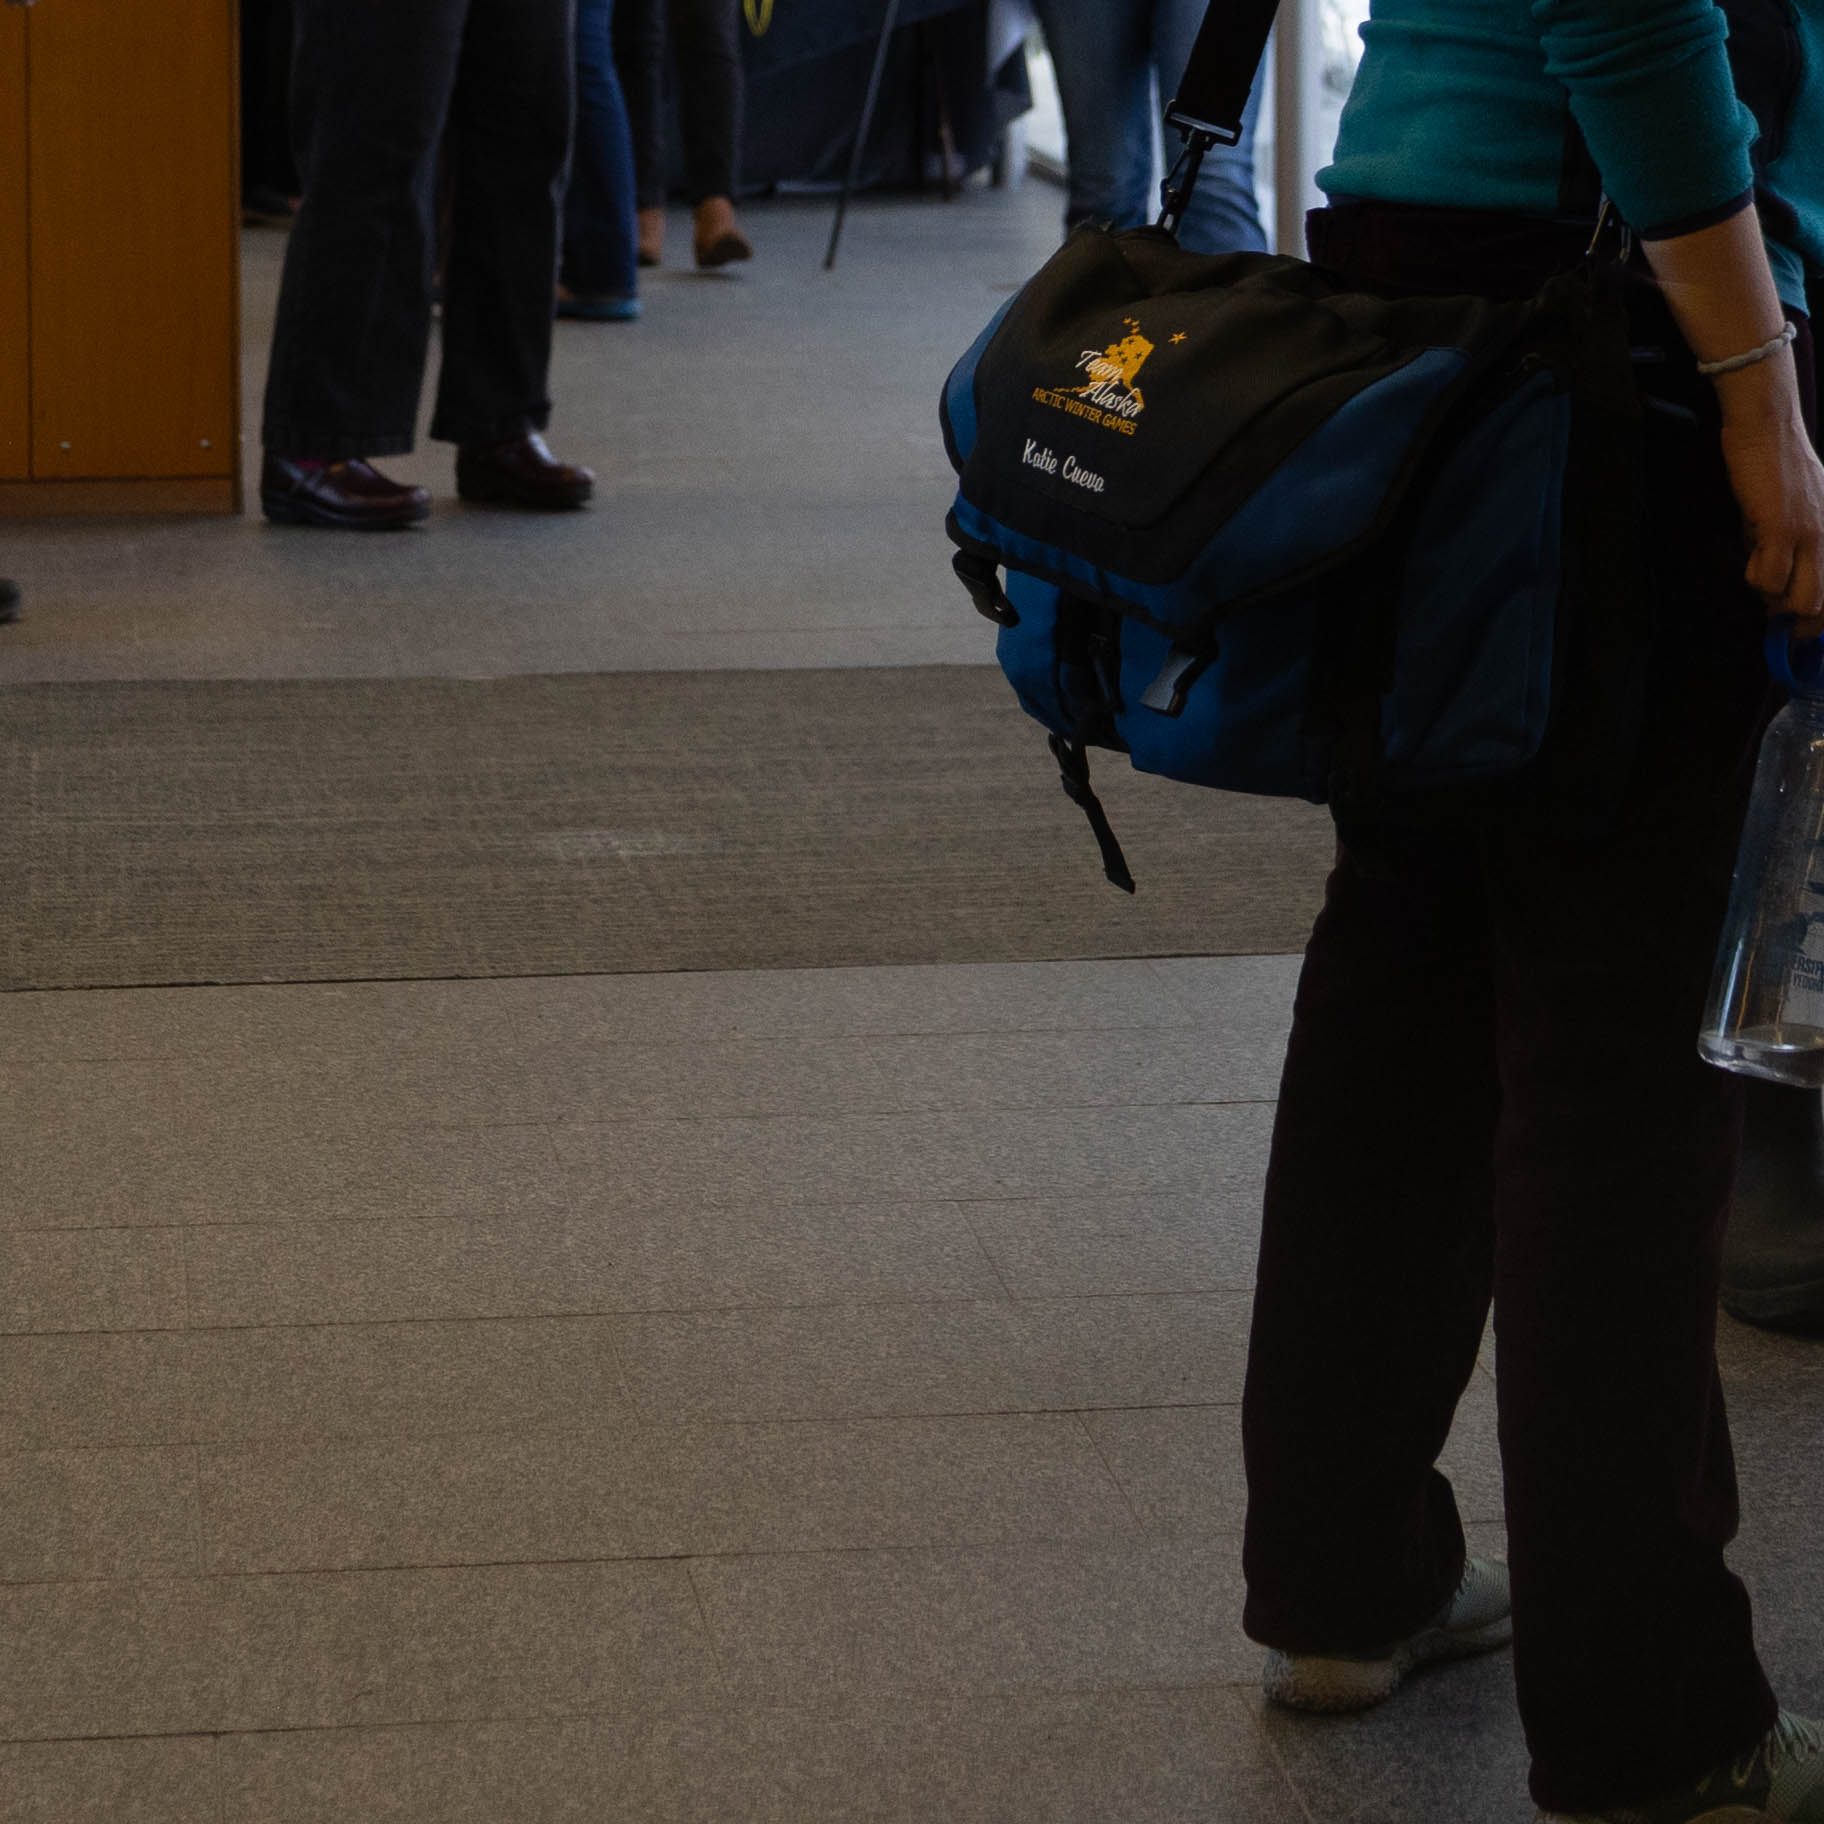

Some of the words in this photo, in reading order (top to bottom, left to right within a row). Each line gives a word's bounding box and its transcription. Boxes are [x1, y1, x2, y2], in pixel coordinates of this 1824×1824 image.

[1075, 350, 1124, 382] Team
[1032, 387, 1066, 409] ARCTIC
[1064, 398, 1103, 425] WINTER
[1102, 413, 1137, 436] GAMES
[1079, 380, 1144, 418] Alaska
[1022, 438, 1058, 474] Katie
